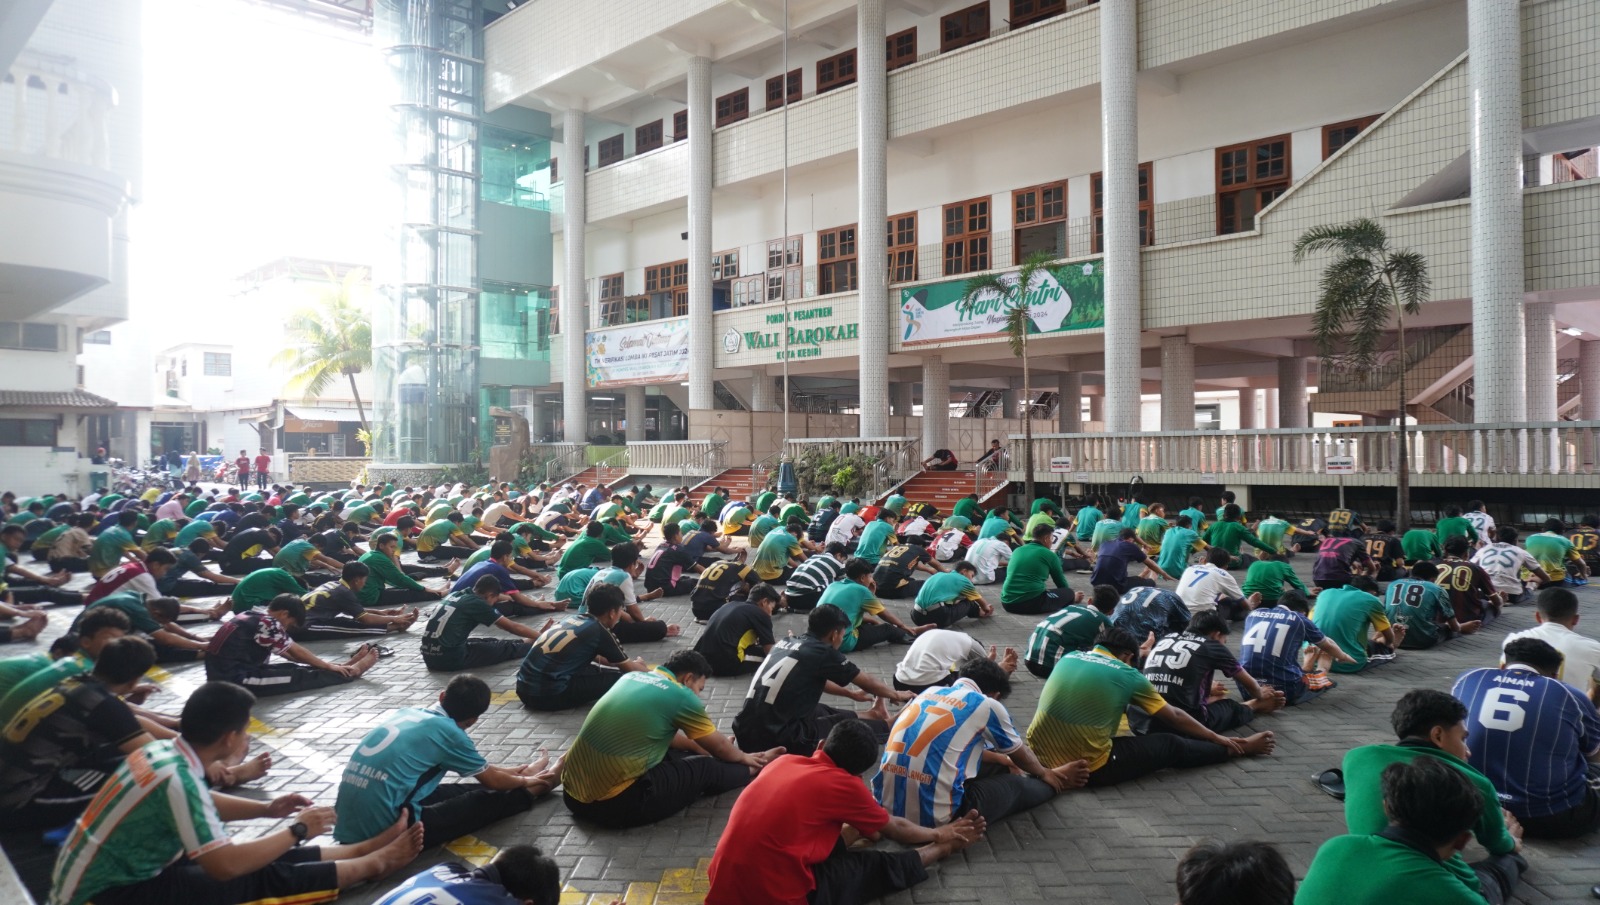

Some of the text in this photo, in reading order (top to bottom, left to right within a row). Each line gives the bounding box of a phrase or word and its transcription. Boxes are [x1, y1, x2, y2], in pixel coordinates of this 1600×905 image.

[766, 306, 832, 324] PONDK PESANTREN
[743, 322, 859, 350] WALI BAROKAH
[797, 347, 821, 358] KEDIRI
[1328, 510, 1351, 525] 09
[1365, 539, 1386, 558] 19
[1570, 533, 1600, 551] 03
[1481, 548, 1518, 568] 25
[1187, 570, 1210, 588] 7
[1434, 563, 1473, 592] 20
[1390, 583, 1426, 608] 18
[1241, 620, 1290, 658] 41
[1143, 638, 1201, 670] 25
[1492, 675, 1535, 688] AIMAN
[1478, 686, 1530, 732] 6
[358, 714, 425, 757] 5
[885, 702, 957, 758] 27
